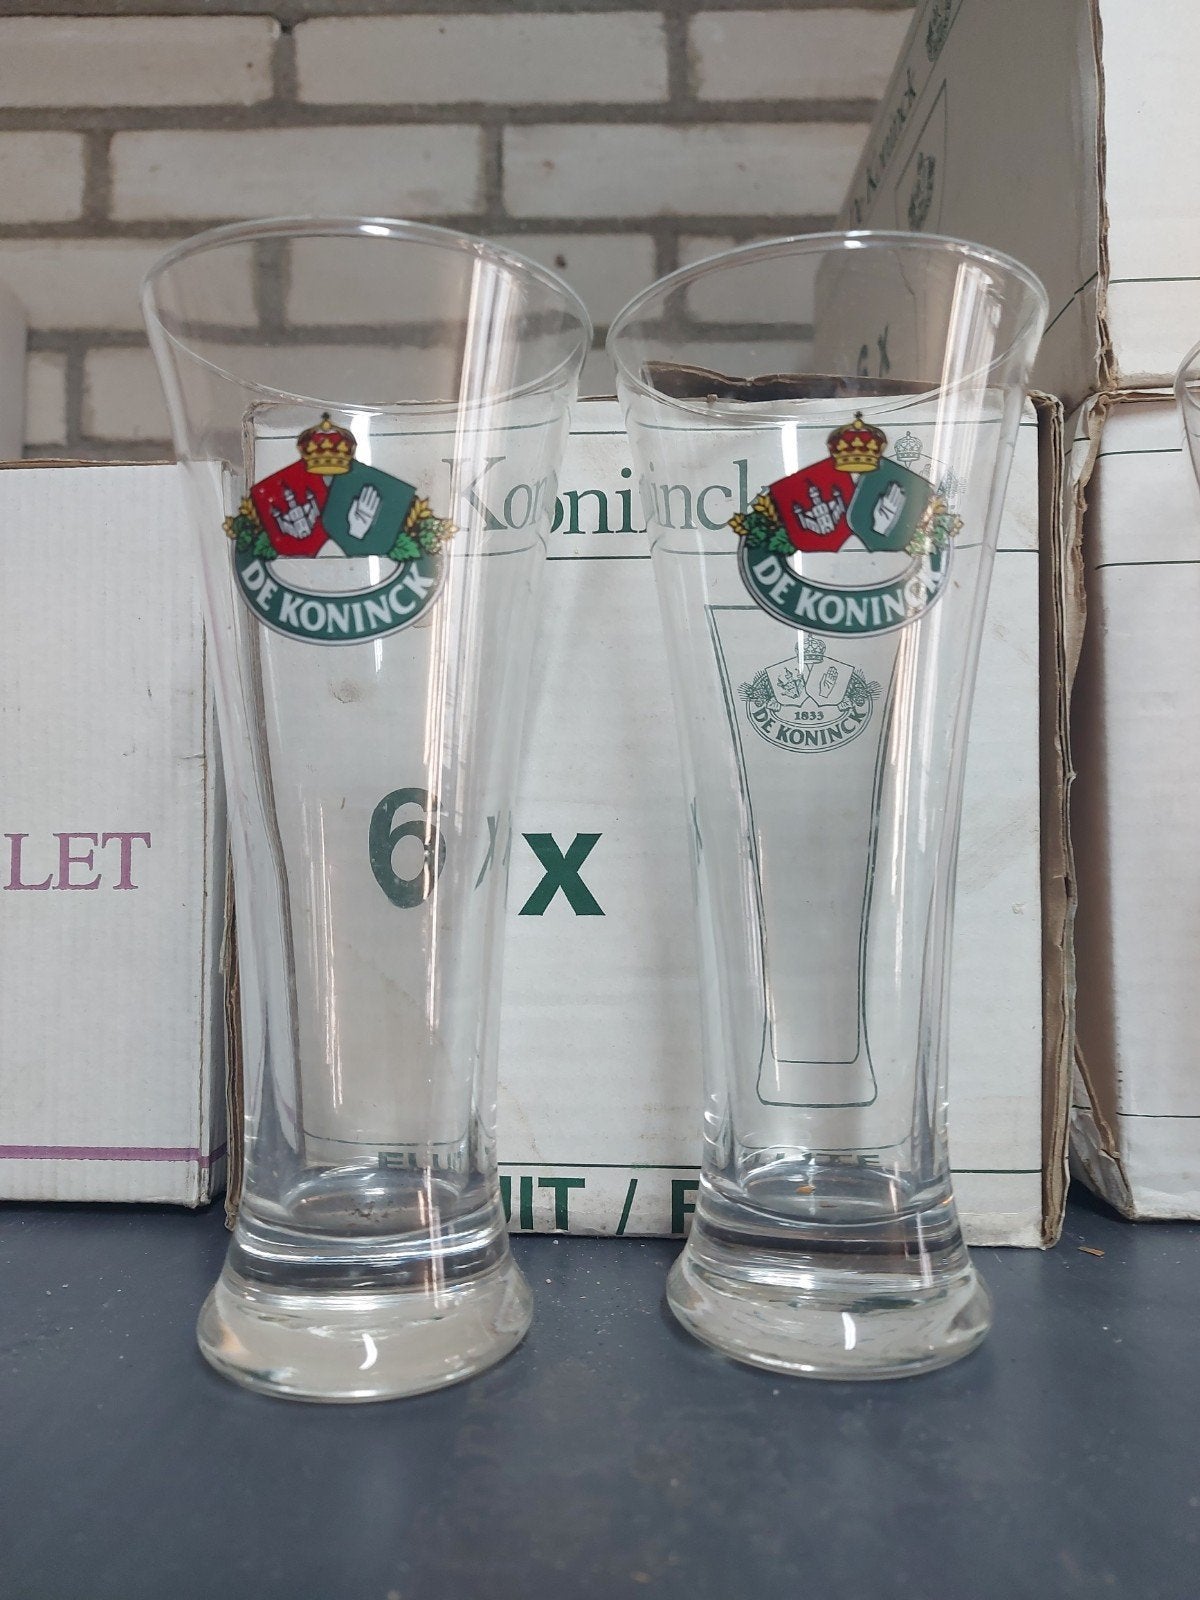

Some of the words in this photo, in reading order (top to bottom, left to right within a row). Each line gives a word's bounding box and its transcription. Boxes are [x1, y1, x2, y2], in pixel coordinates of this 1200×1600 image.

[241, 559, 278, 611] DE
[279, 562, 434, 633] KONINCK
[753, 555, 796, 604] DE
[795, 553, 945, 626] KONINCK
[752, 708, 775, 733] DE
[776, 706, 866, 746] KONINCK
[794, 711, 825, 721] 1833
[3, 833, 151, 890] LET
[369, 787, 446, 909] 6
